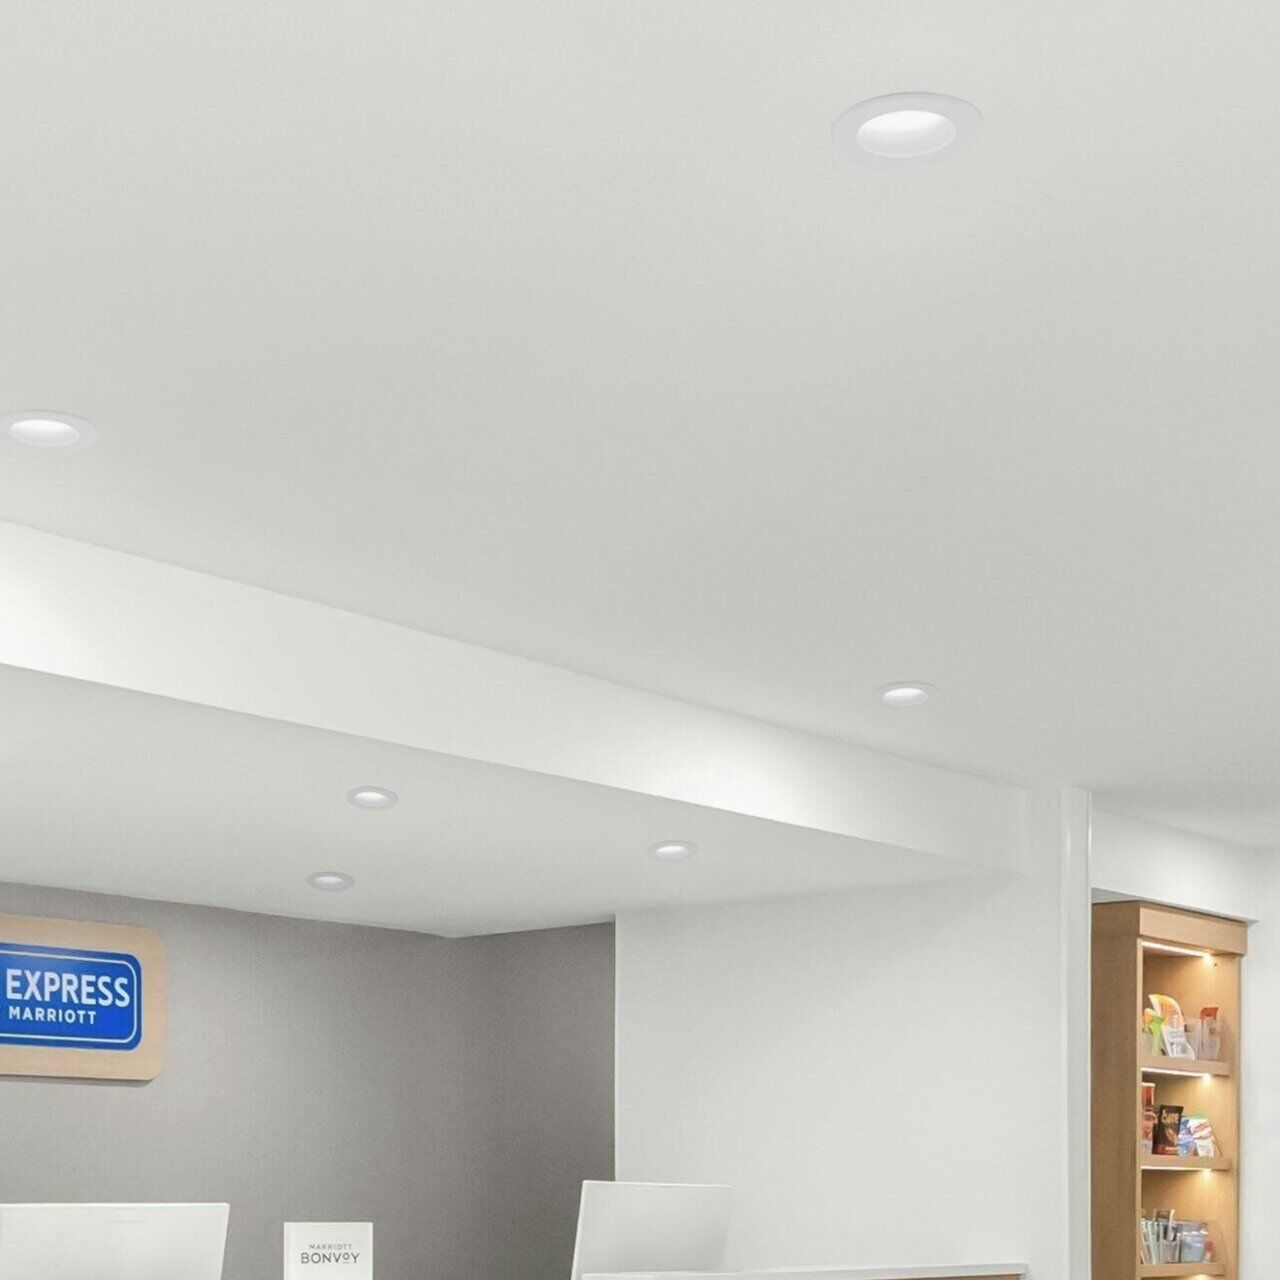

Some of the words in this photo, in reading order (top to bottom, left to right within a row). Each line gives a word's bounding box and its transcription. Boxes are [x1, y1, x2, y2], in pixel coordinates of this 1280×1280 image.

[5, 967, 131, 1008] EXPRESS
[7, 1005, 97, 1025] MARRIOTT
[300, 1252, 360, 1264] BONVOY
